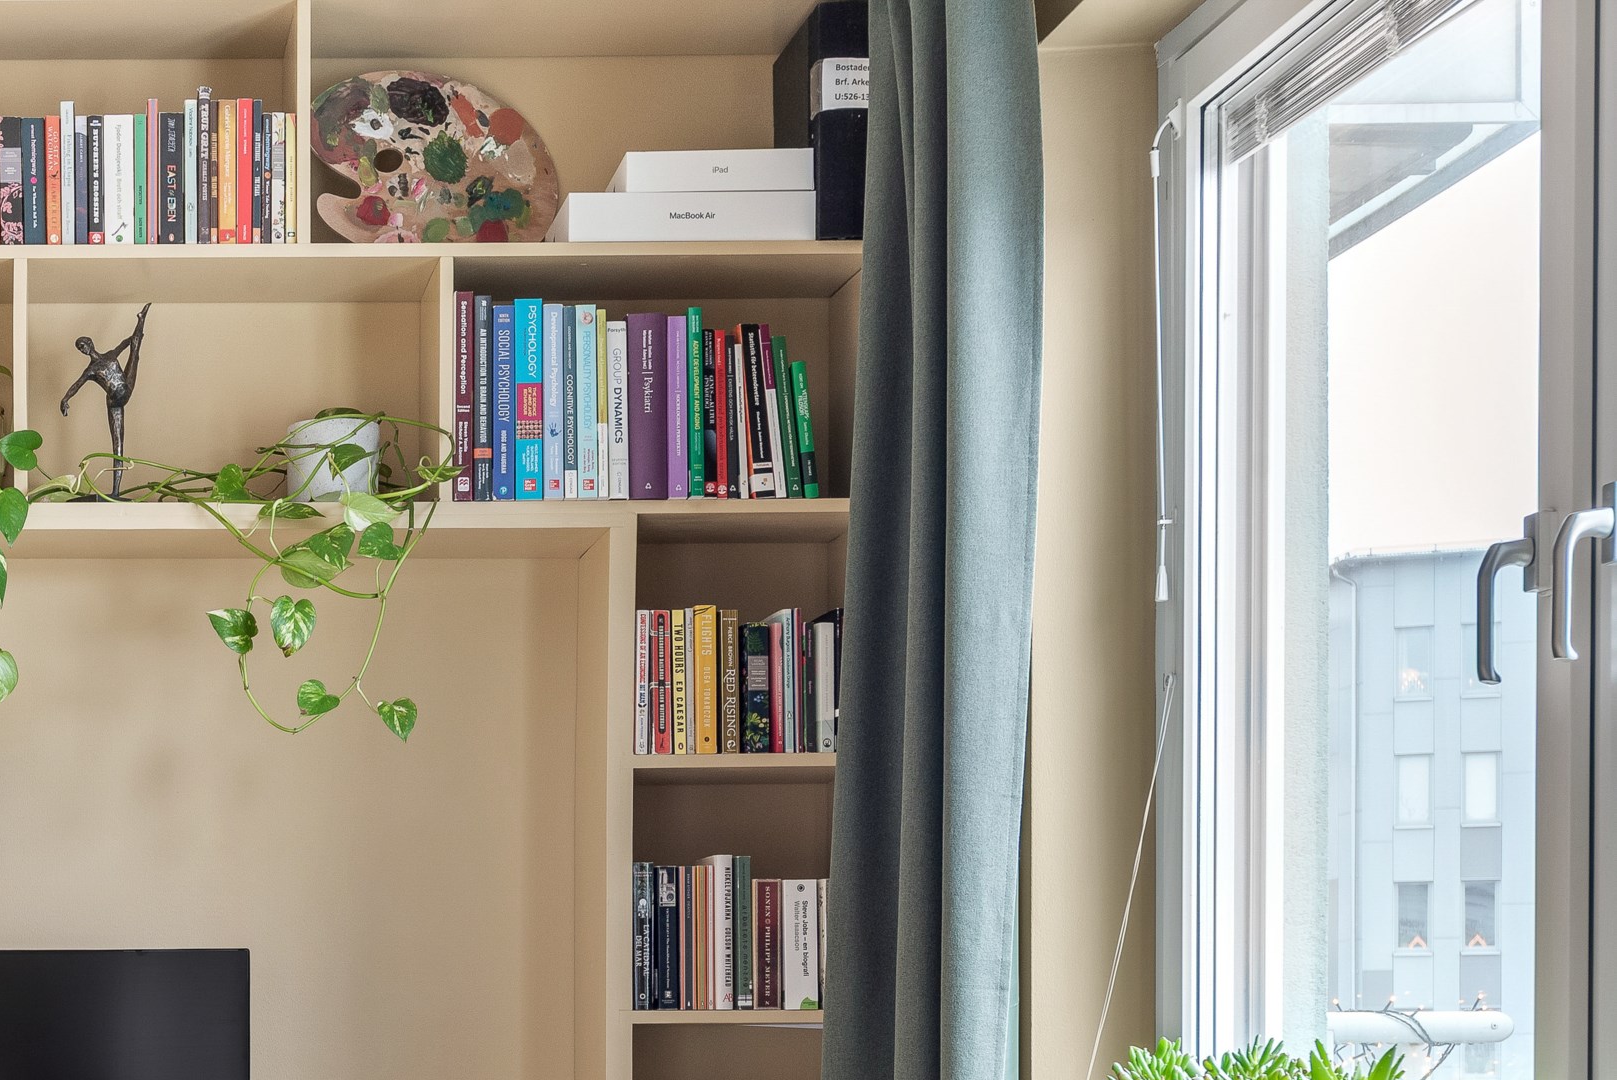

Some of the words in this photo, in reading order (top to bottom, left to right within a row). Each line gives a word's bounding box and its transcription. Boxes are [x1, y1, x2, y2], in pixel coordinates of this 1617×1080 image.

[835, 78, 850, 86] Brf.
[201, 104, 209, 131] TRUE
[201, 132, 209, 159] GRIT
[223, 150, 231, 177] Márquez
[712, 165, 729, 174] iPad
[669, 211, 704, 220] MacBook
[705, 211, 716, 219] Air
[460, 301, 468, 337] Sensation
[460, 339, 468, 354] and
[498, 330, 510, 361] SOCIAL
[527, 305, 537, 378] PSYCHOLOGY
[550, 312, 558, 367] Developmental
[692, 340, 700, 358] ADULT
[748, 332, 756, 356] Statistik
[583, 331, 591, 380] PERSONALITY
[613, 348, 622, 385] GROUP
[459, 355, 468, 394] Perception
[480, 376, 487, 385] TO
[549, 367, 558, 407] Psychology
[751, 365, 760, 406] beteendevetare
[498, 364, 510, 422] PSYCHOLOGY
[566, 374, 574, 415] COGNITIVE
[583, 382, 592, 430] PSYCHOLOGY
[644, 377, 653, 413] Psykiatri
[479, 415, 487, 444] BEHAVIOR
[613, 387, 623, 444] DYNAMICS
[693, 411, 701, 430] AGING
[566, 416, 574, 465] PSYCHOLOGY
[674, 624, 684, 642] TWO
[701, 614, 713, 656] FLIGHTS
[674, 645, 684, 674] HOURS
[676, 681, 684, 692] ED
[703, 667, 711, 684] OLGA
[723, 669, 736, 693] RED
[676, 697, 684, 733] CAESAR
[703, 688, 711, 728] TOKARCZUK
[723, 697, 736, 736] RISING
[644, 924, 650, 935] LA
[803, 942, 808, 951] en
[801, 951, 810, 977] biografi
